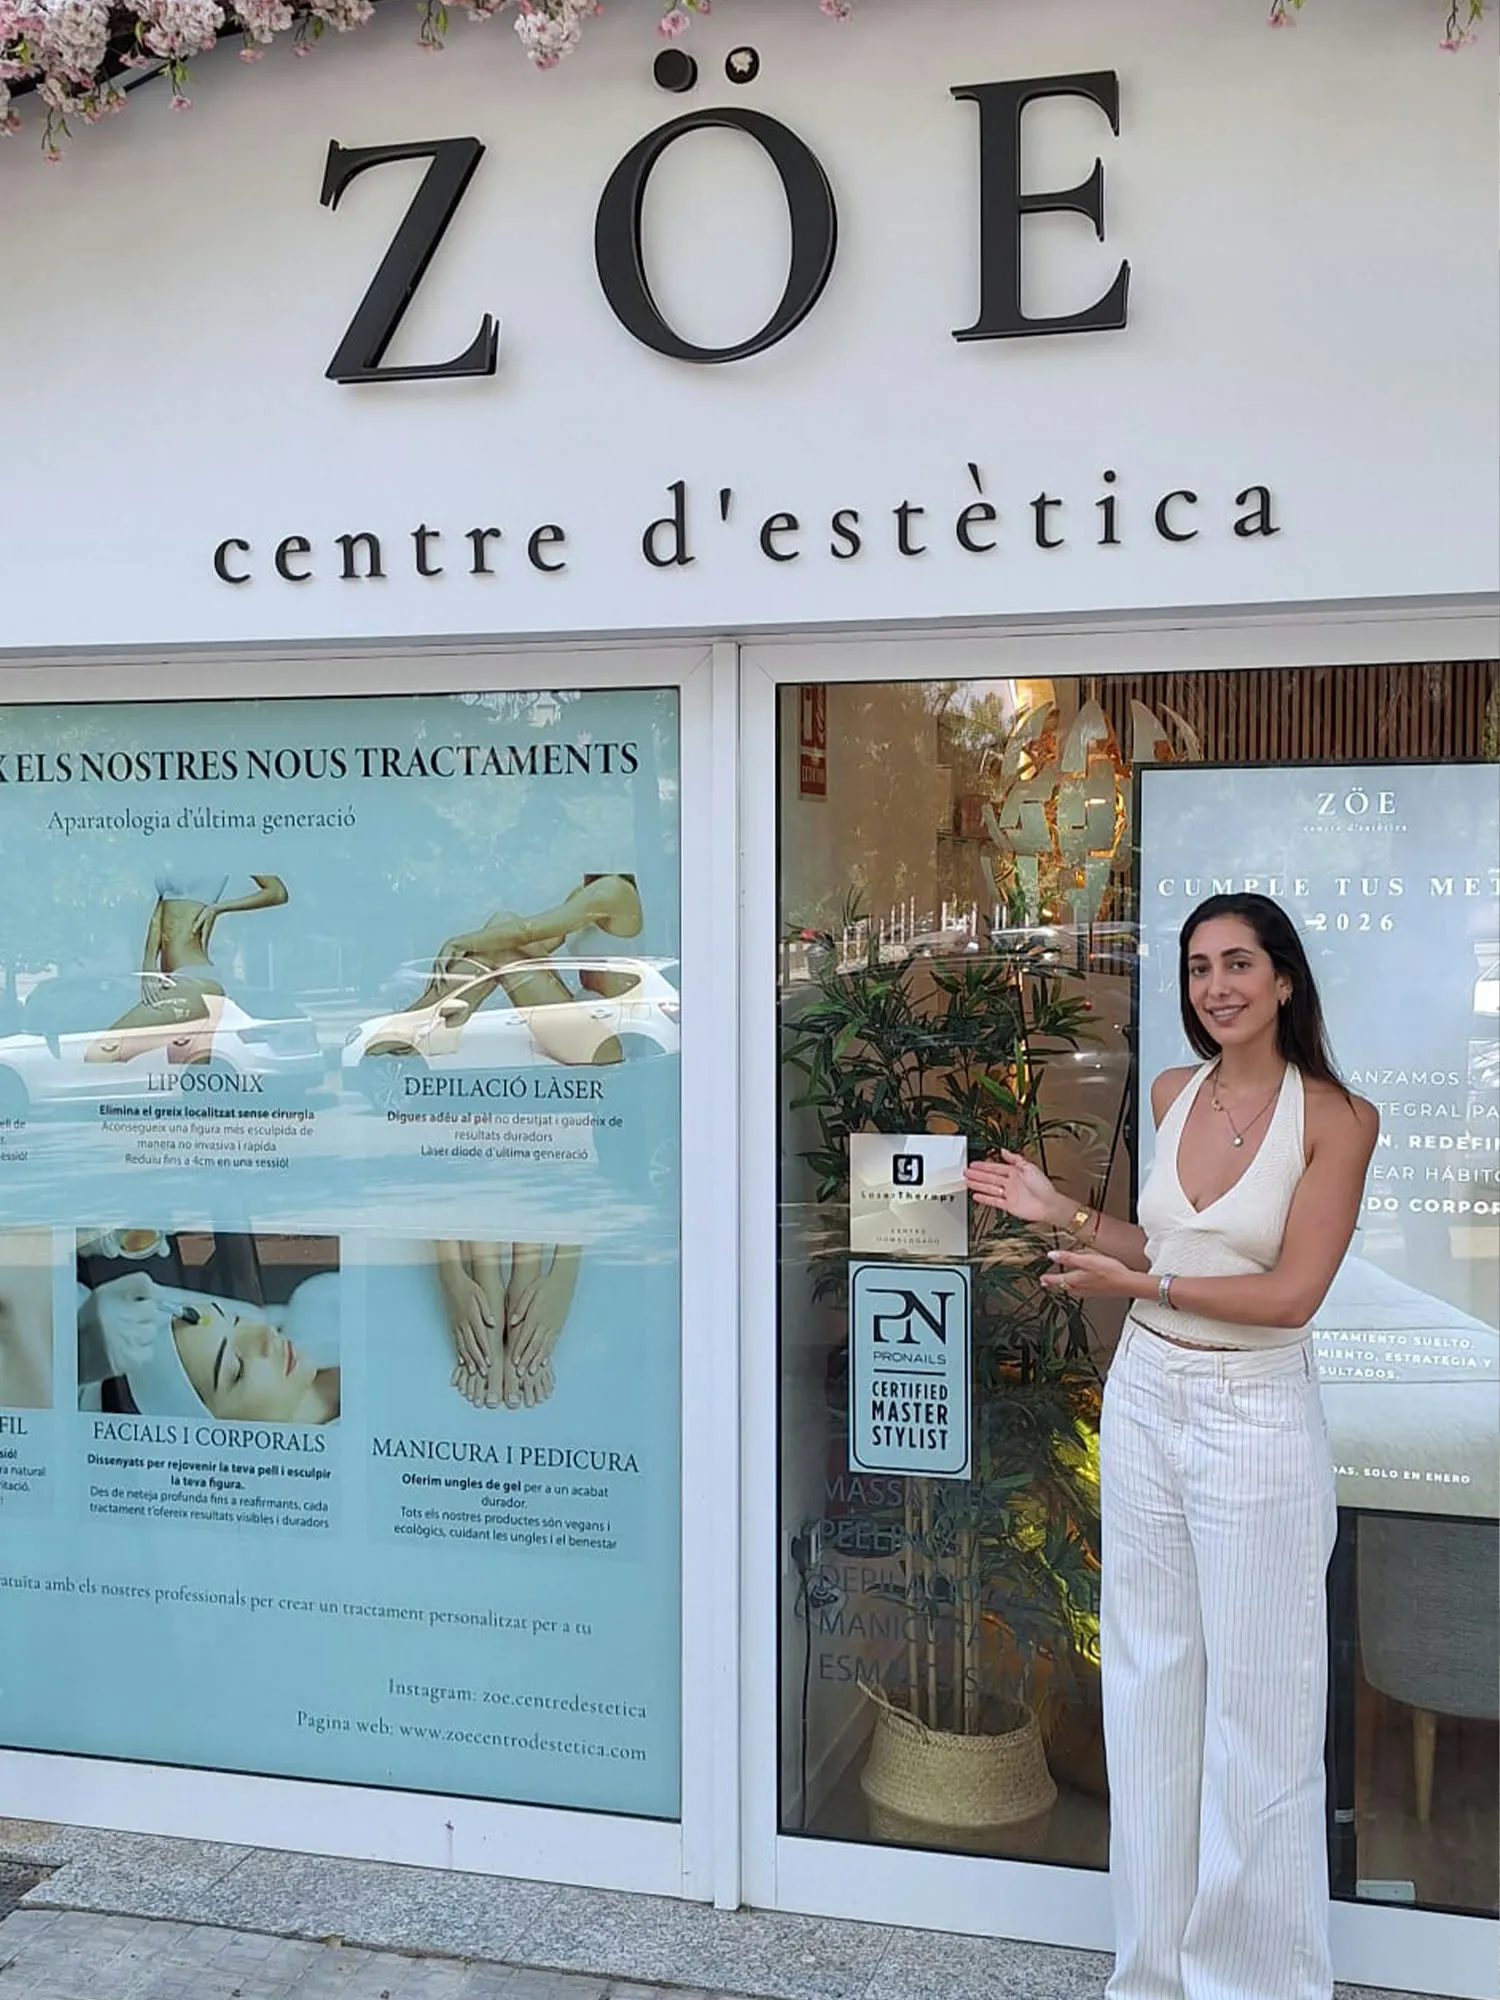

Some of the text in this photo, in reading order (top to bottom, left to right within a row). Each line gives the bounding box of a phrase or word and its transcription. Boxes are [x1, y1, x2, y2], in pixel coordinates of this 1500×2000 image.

[320, 46, 1130, 383] ZÖE
[213, 462, 1280, 584] centre d'estètica
[16, 753, 72, 783] ELS
[80, 750, 238, 782] NOSTRES
[247, 748, 347, 780] NOUS
[355, 742, 639, 778] TRACTAMENTS
[1317, 786, 1397, 817] ZÖE
[48, 805, 356, 836] Aparatologia d'última generació
[1158, 878, 1311, 897] CUMPLE
[1335, 878, 1405, 897] TUS
[1314, 911, 1395, 932] 2026
[147, 1072, 264, 1094] LIPOSONIX
[404, 1075, 604, 1100] DEPILACIÓ LÀSER
[13, 1117, 26, 1129] de
[99, 1104, 315, 1122] Elimina el greix localitzat sense cirurgia
[388, 1110, 427, 1124] Digues
[460, 1112, 472, 1123] al
[495, 1115, 509, 1124] no
[561, 1115, 606, 1128] gaudeix
[608, 1116, 623, 1127] de
[169, 1124, 188, 1133] una
[190, 1122, 220, 1136] figura
[247, 1124, 297, 1136] esculpida
[300, 1126, 314, 1136] de
[455, 1130, 553, 1142] resultats duradors
[178, 1140, 192, 1149] no
[533, 1149, 588, 1160] generació
[217, 1158, 231, 1168] en
[233, 1159, 253, 1168] una
[873, 1350, 947, 1366] PRONAILS
[1386, 1352, 1477, 1368] ESTRATEGIA
[1484, 1358, 1492, 1368] Y
[872, 1380, 949, 1402] CERTIFIED
[871, 1402, 949, 1426] MASTER
[93, 1421, 326, 1453] FACIALS I CORPORALS
[871, 1425, 949, 1450] STYLIST
[87, 1454, 144, 1469] Dissenyats
[147, 1459, 165, 1472] per
[167, 1457, 217, 1475] rejovenir
[219, 1461, 230, 1473] la
[232, 1463, 255, 1475] teva
[257, 1463, 280, 1478] pell
[287, 1466, 332, 1481] esculpir
[372, 1438, 640, 1474] MANICURA I PEDICURA
[171, 1475, 245, 1491] la teva figura.
[402, 1473, 608, 1498] Oferim ungles de gel per a un acabat
[1364, 1468, 1398, 1479] SOLO
[1403, 1471, 1421, 1481] EN
[90, 1486, 329, 1512] Des de neteja profunda fins a reafirmants, cada
[481, 1496, 528, 1509] durador.
[90, 1502, 145, 1516] tractament
[147, 1503, 188, 1518] t'ofereix
[190, 1507, 234, 1521] resultats
[236, 1510, 274, 1525] visibles
[282, 1513, 329, 1528] duradors
[401, 1506, 422, 1519] Tots
[424, 1509, 440, 1520] els
[442, 1510, 482, 1523] nostres
[485, 1513, 539, 1528] productes
[542, 1515, 562, 1528] són
[564, 1518, 605, 1533] vegans
[394, 1523, 447, 1539] ecològics,
[449, 1527, 491, 1541] cuidant
[492, 1530, 508, 1541] les
[510, 1532, 547, 1546] ungles
[555, 1534, 567, 1546] el
[568, 1535, 618, 1550] benestar
[45, 1576, 593, 1636] amb els nostres professionals per crear un tractament personalitzat per a tu
[388, 1677, 647, 1720] Instagram: zoe.centredestetica
[356, 1717, 394, 1737] web:
[399, 1723, 647, 1762] www.zoecentrodestetica.com
